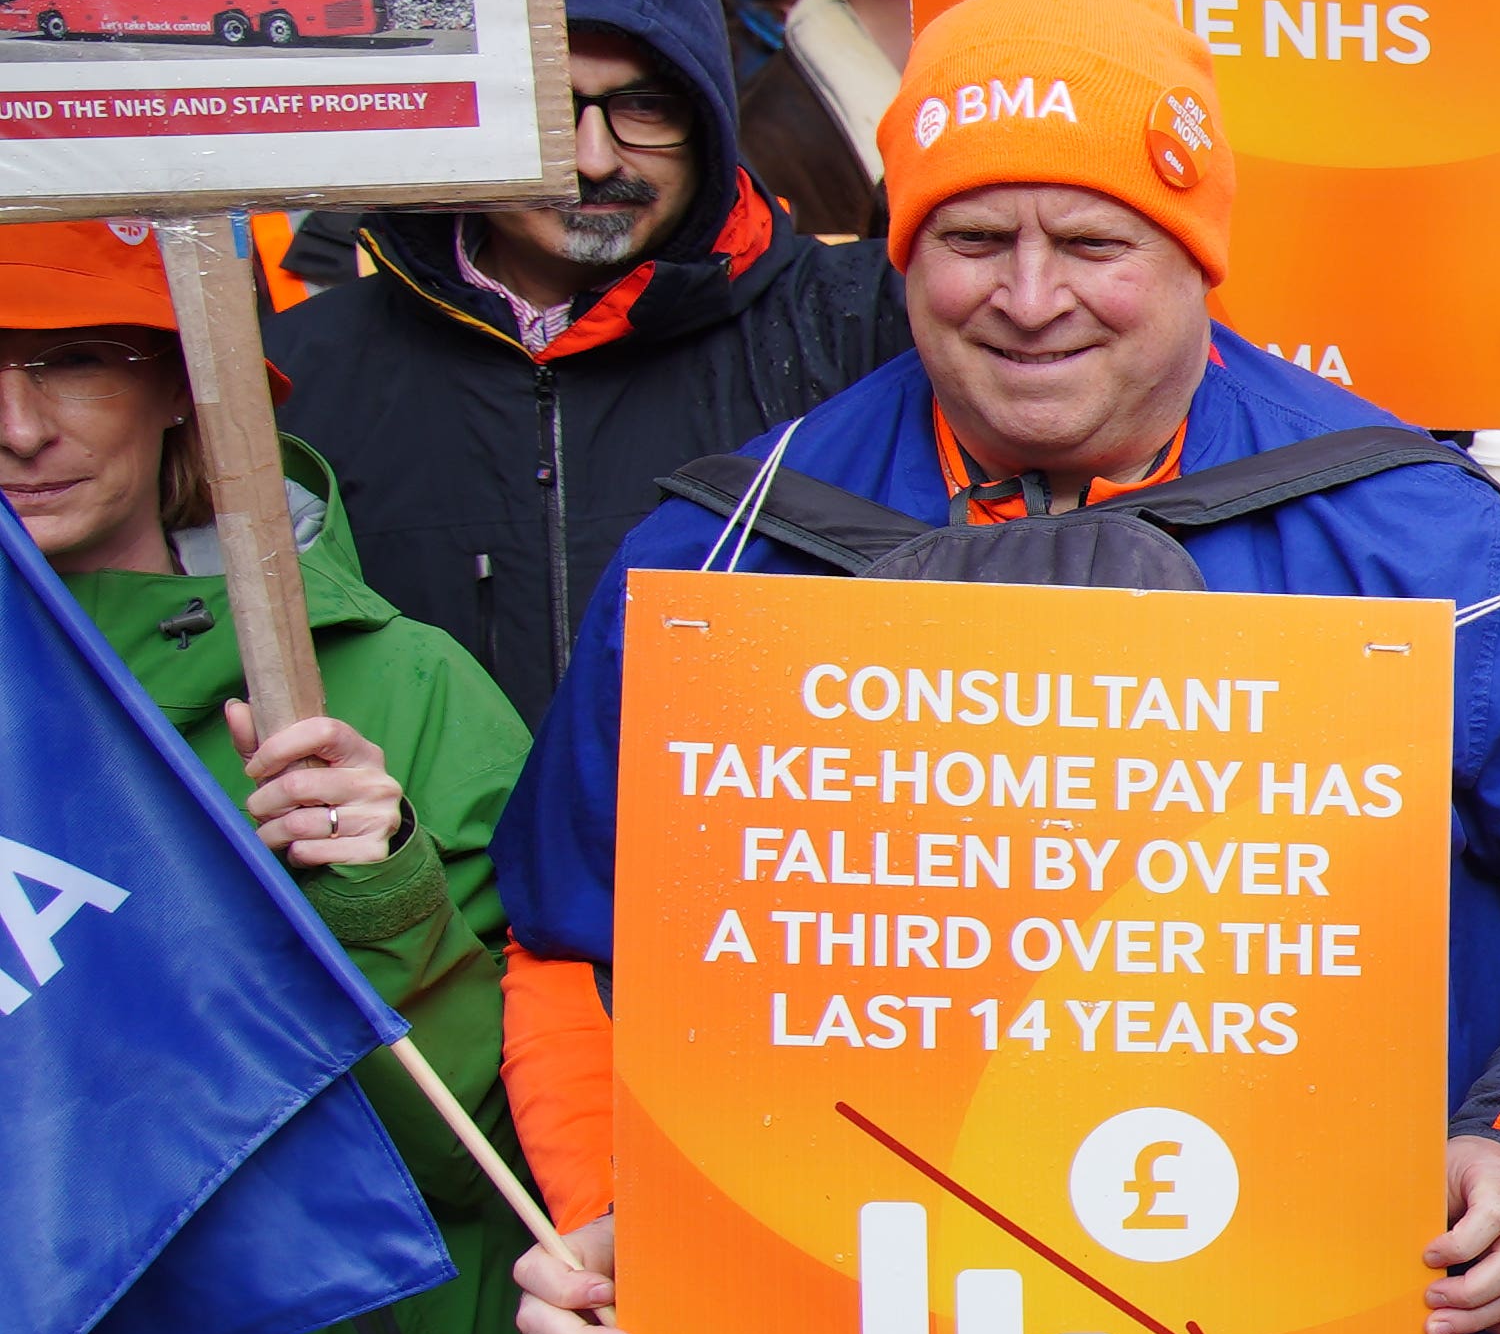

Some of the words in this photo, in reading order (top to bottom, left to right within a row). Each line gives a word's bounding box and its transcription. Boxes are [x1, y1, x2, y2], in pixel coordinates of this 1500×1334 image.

[124, 21, 146, 31] take
[148, 21, 171, 32] back
[173, 20, 212, 32] control
[1263, 0, 1431, 65] NHS
[0, 101, 53, 120] UND
[59, 101, 108, 120] THE
[115, 99, 166, 118] NHS
[173, 97, 227, 116] AND
[233, 95, 304, 115] STAFF
[311, 92, 428, 114] PROPERLY
[955, 76, 1078, 126] BMA
[1166, 94, 1213, 151] RESTORATION
[1183, 95, 1208, 126] PAY
[1172, 117, 1202, 152] NOW
[1264, 343, 1354, 387] MA
[800, 663, 1280, 733] CONSULTANT
[666, 741, 1097, 810] TAKE-HOME
[1114, 757, 1243, 813] PAY
[1259, 761, 1403, 818] HAS
[741, 827, 1011, 889] FALLEN
[1032, 836, 1121, 891] BY
[1135, 839, 1330, 896] OVER
[703, 909, 757, 963] A
[768, 910, 992, 969] THIRD
[1008, 917, 1205, 974] OVER
[1218, 922, 1362, 976] THE
[770, 992, 952, 1050] LAST
[969, 998, 1051, 1051] 14
[1064, 999, 1298, 1055] YEARS
[1122, 1140, 1189, 1230] £
